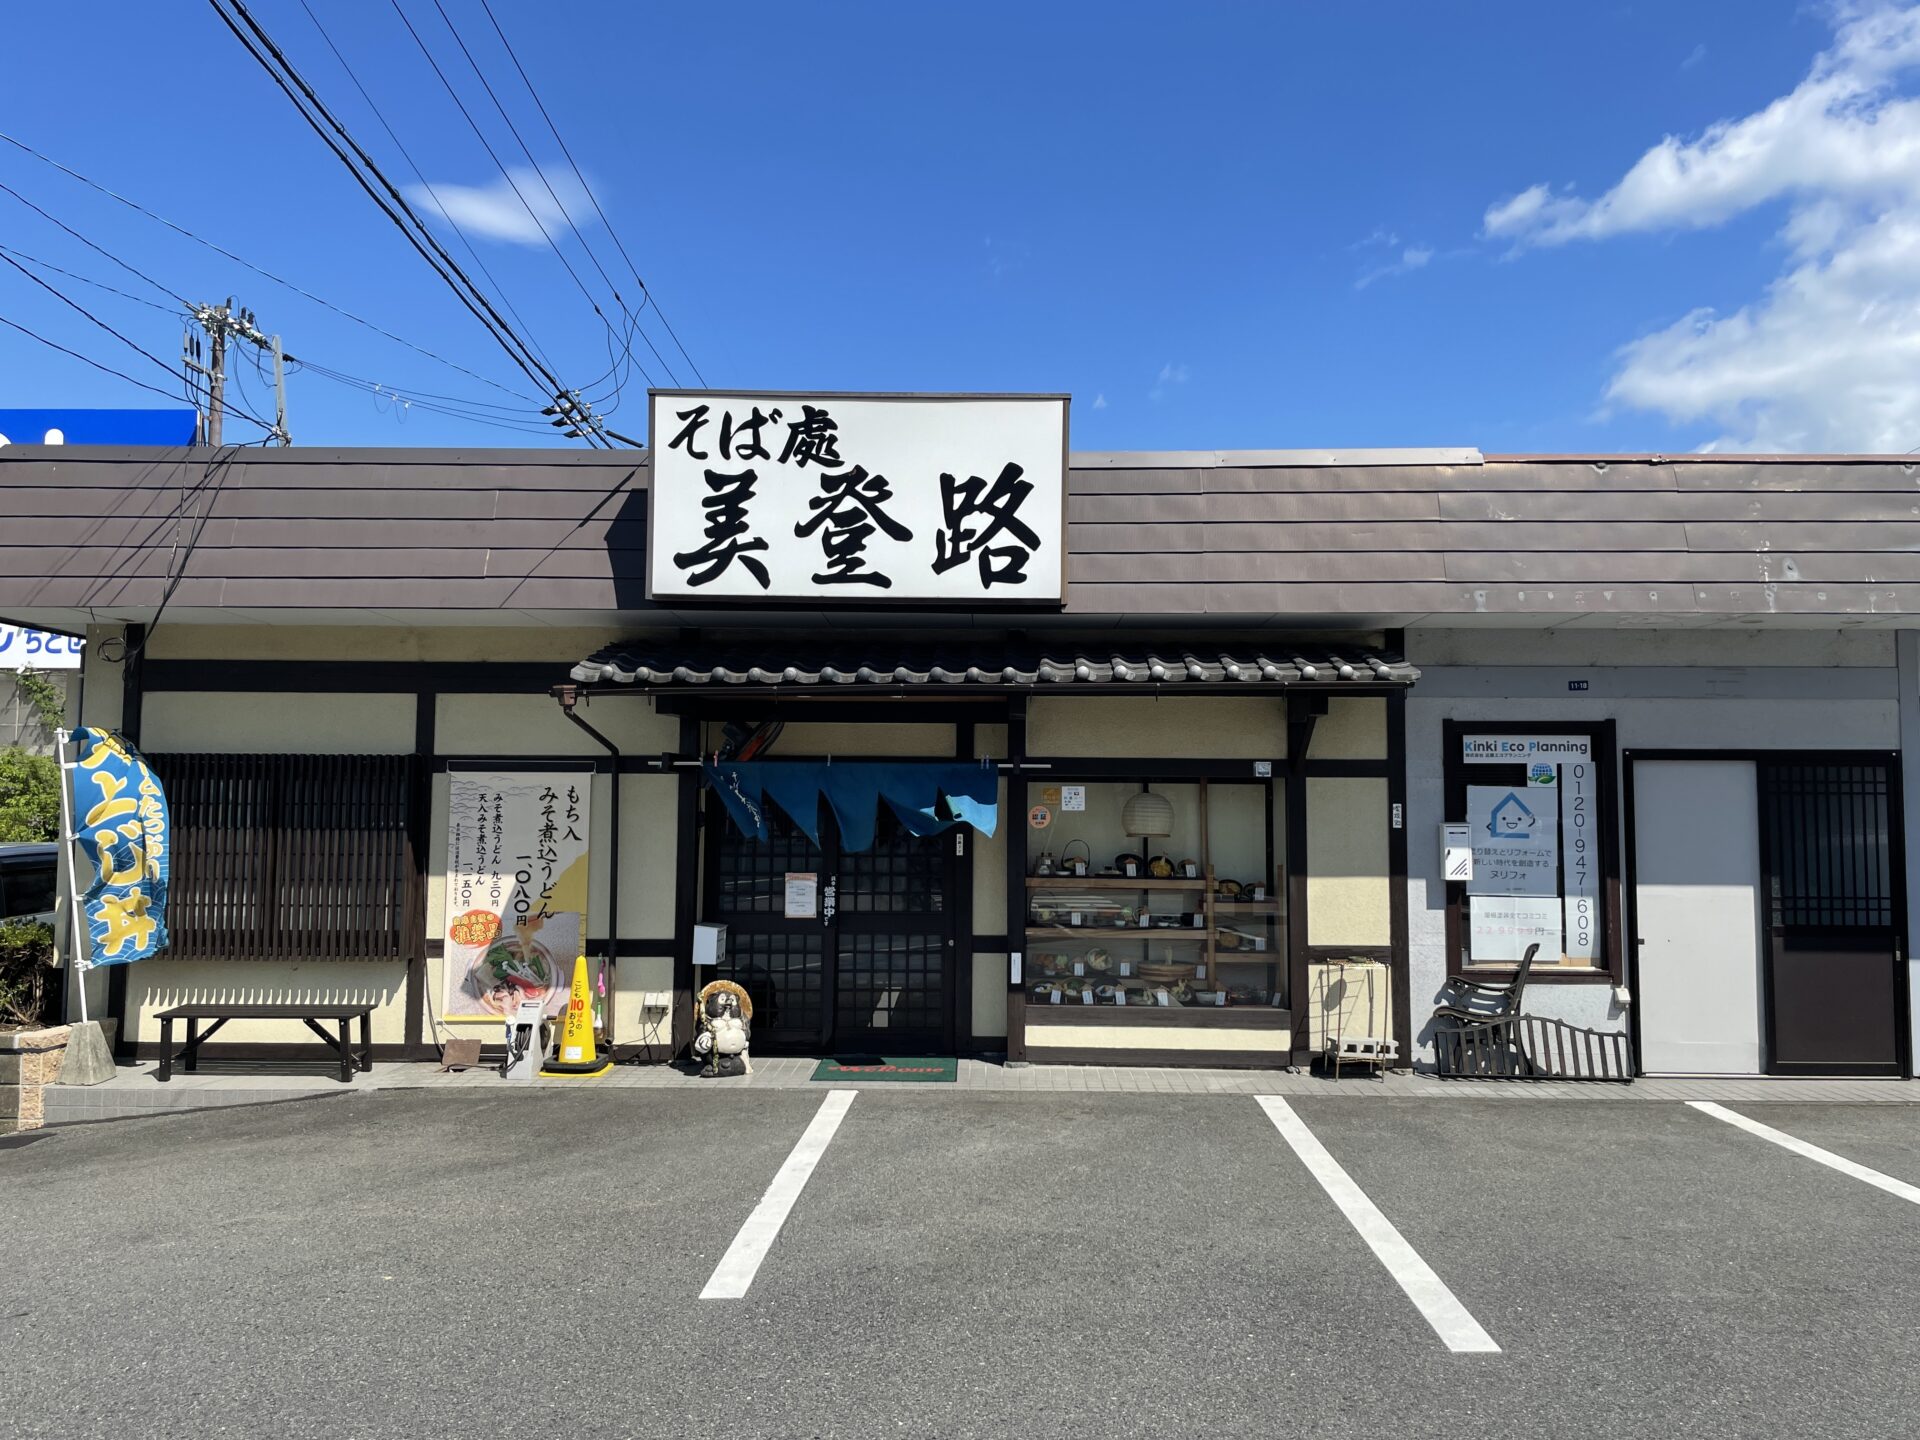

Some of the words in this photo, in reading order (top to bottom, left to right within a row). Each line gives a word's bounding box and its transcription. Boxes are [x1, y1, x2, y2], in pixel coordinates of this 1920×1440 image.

[667, 404, 846, 468] そば處
[672, 461, 1042, 590] 美登路
[1464, 740, 1497, 752] Kinki
[1501, 741, 1525, 752] Eco
[1529, 740, 1588, 755] Planning
[475, 793, 488, 886] 天入みそ煮込うどん
[491, 793, 504, 865] みそ煮込うどん
[563, 785, 583, 841] もち入
[536, 786, 562, 920] みそ煮込うどん
[1490, 870, 1528, 880] ヌリフォ
[1573, 764, 1590, 947] 0120-947-608
